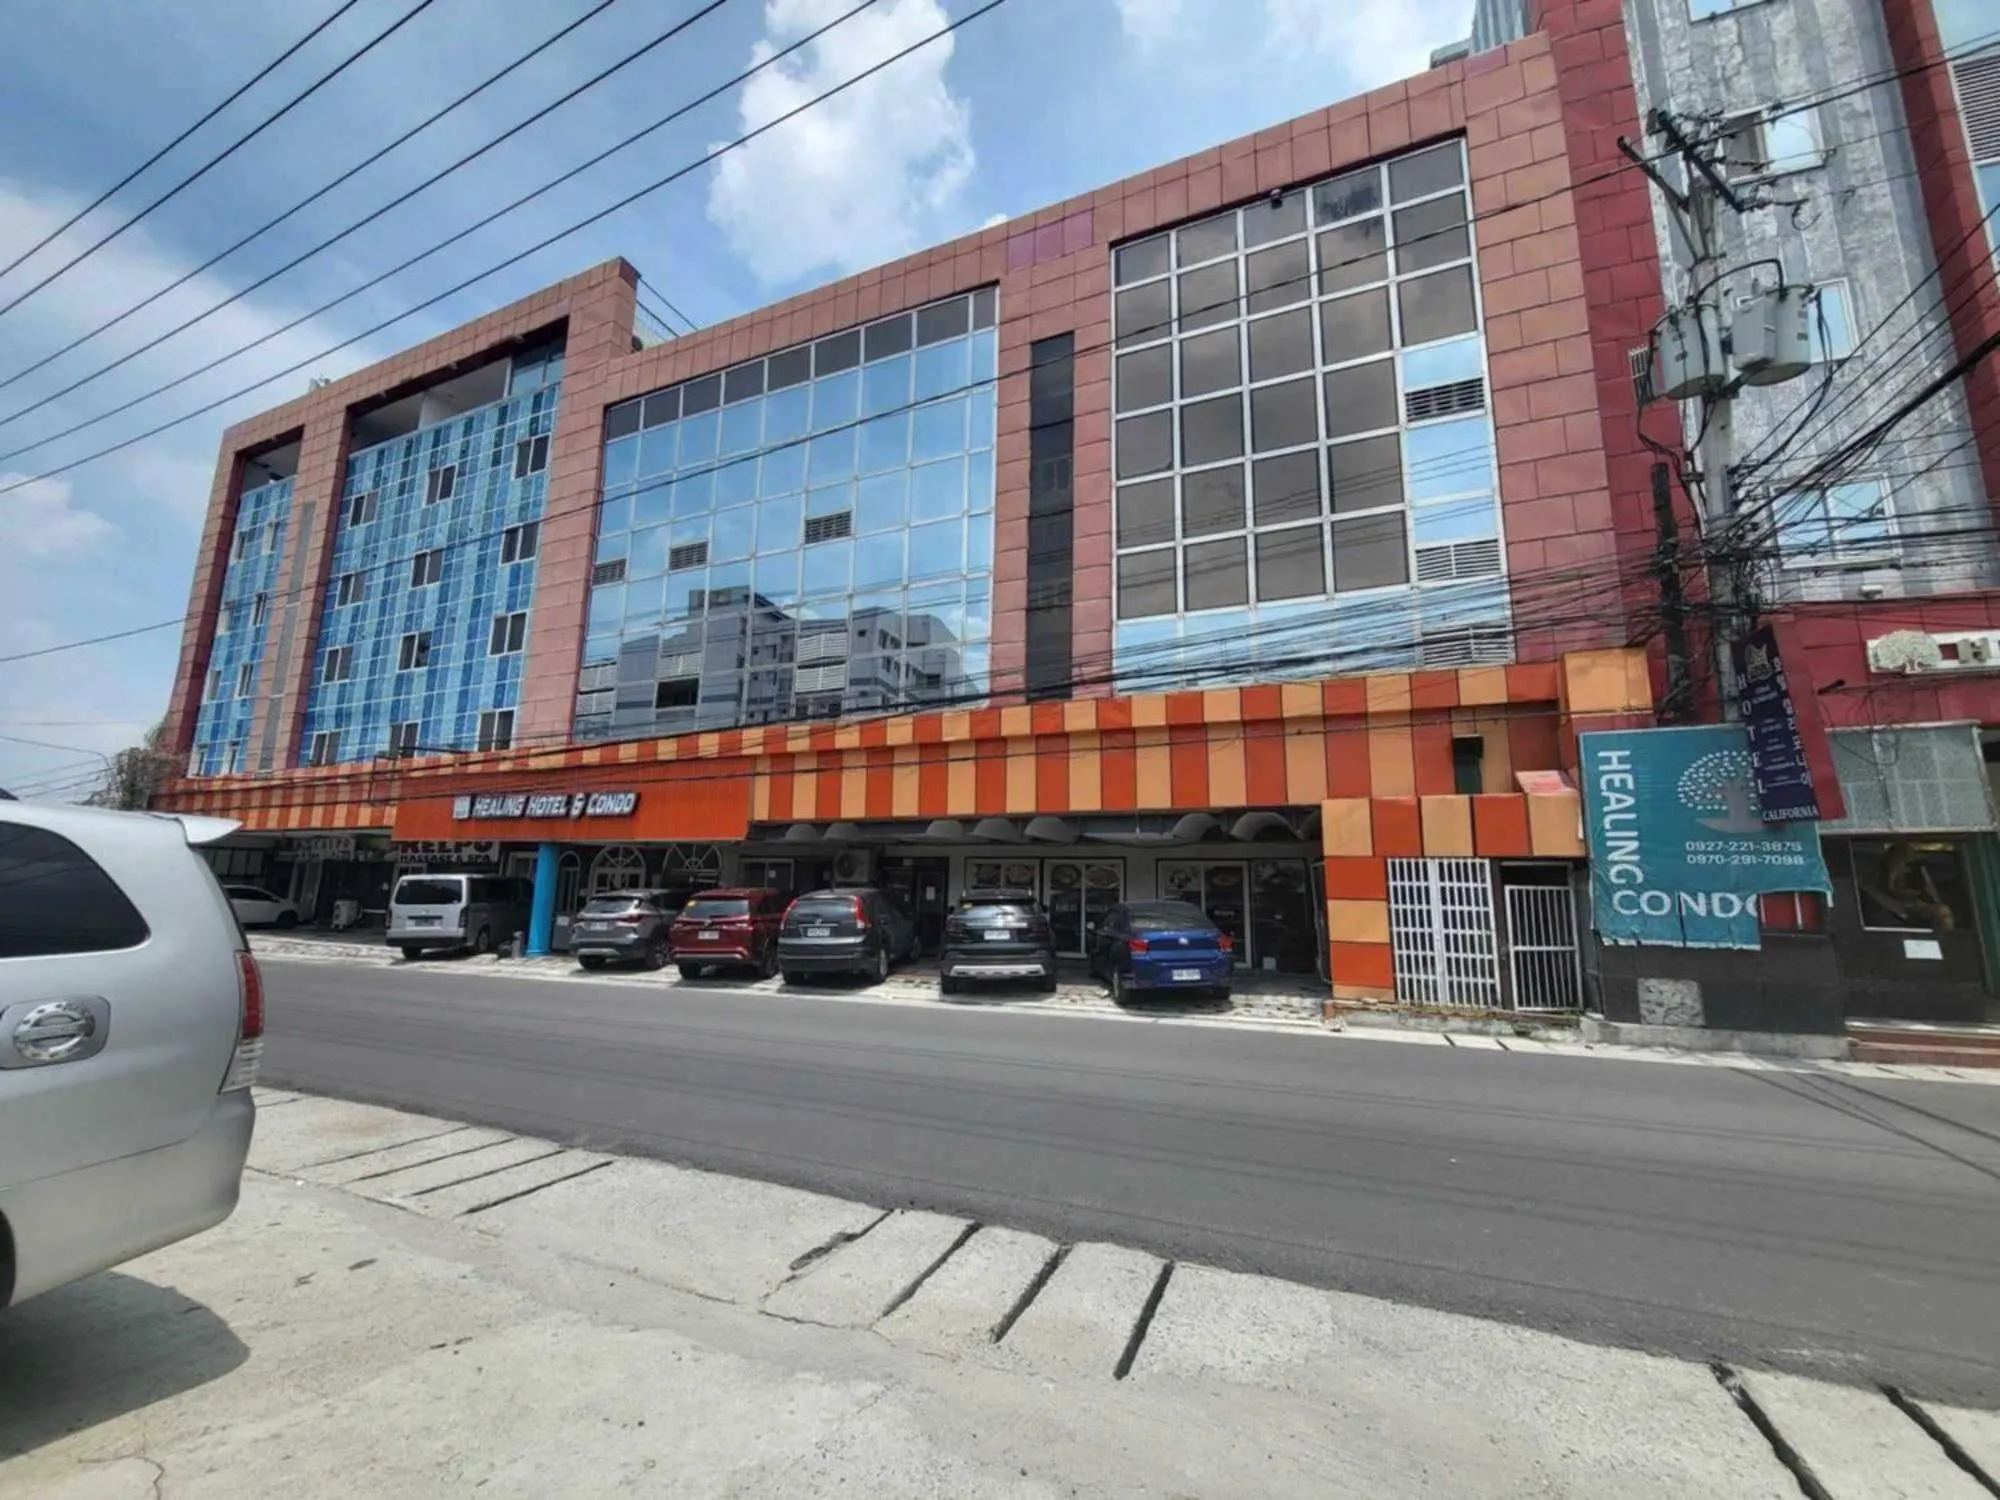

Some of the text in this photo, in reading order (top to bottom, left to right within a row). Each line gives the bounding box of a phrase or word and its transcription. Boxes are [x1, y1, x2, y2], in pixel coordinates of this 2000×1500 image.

[1737, 674, 1768, 794] HOTEL
[472, 795, 525, 818] HEALING
[525, 794, 568, 817] HOTEL
[586, 793, 637, 816] CONDO
[1598, 750, 1644, 884] HEALING
[1762, 804, 1819, 822] CALIFORNIA
